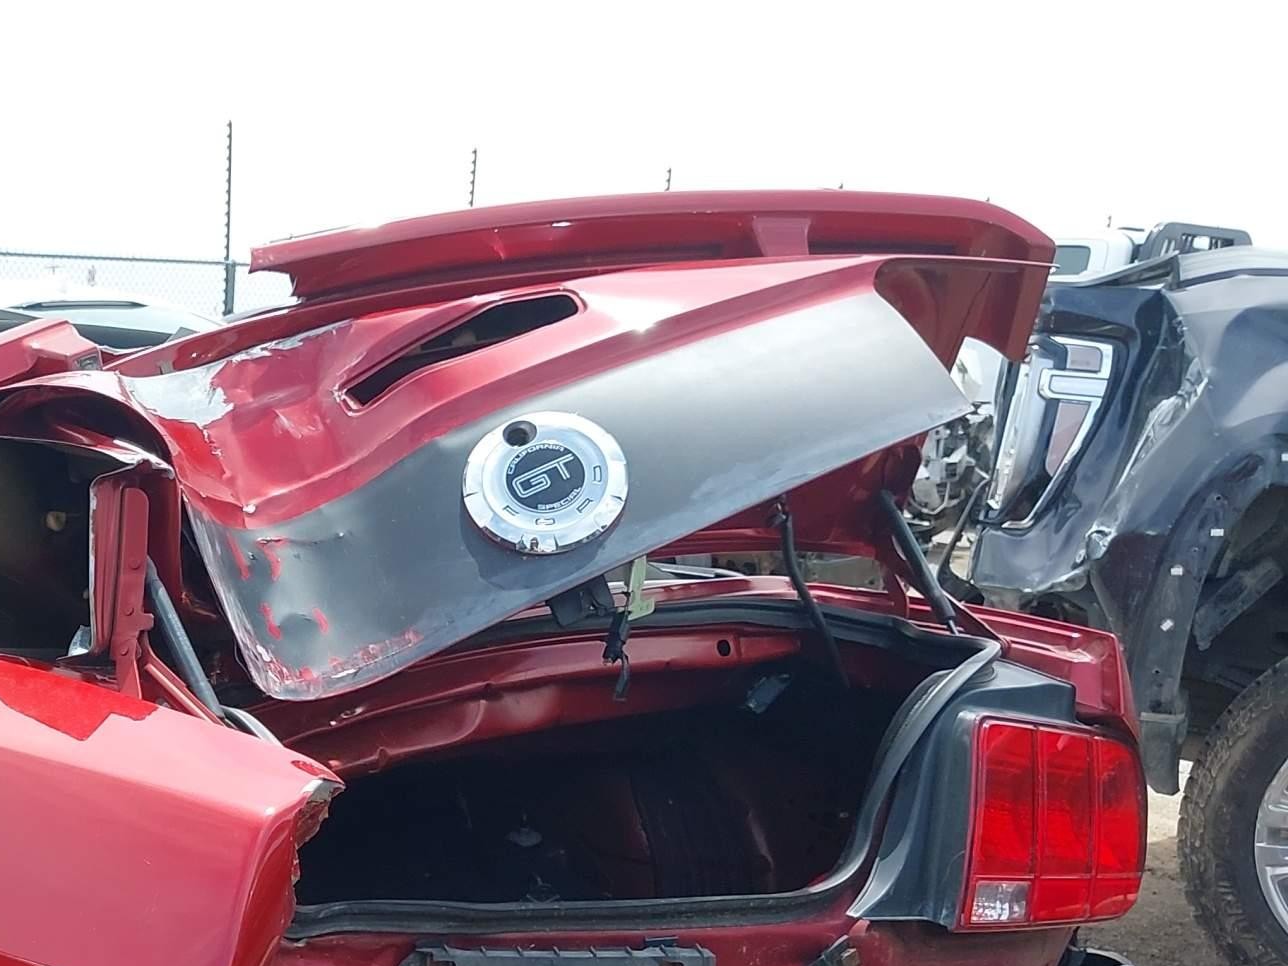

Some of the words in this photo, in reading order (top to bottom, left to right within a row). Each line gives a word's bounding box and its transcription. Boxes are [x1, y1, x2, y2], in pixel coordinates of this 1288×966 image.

[507, 444, 565, 475] CALIFORNIA
[512, 453, 575, 498] GT
[537, 487, 581, 511] SPECIAL
